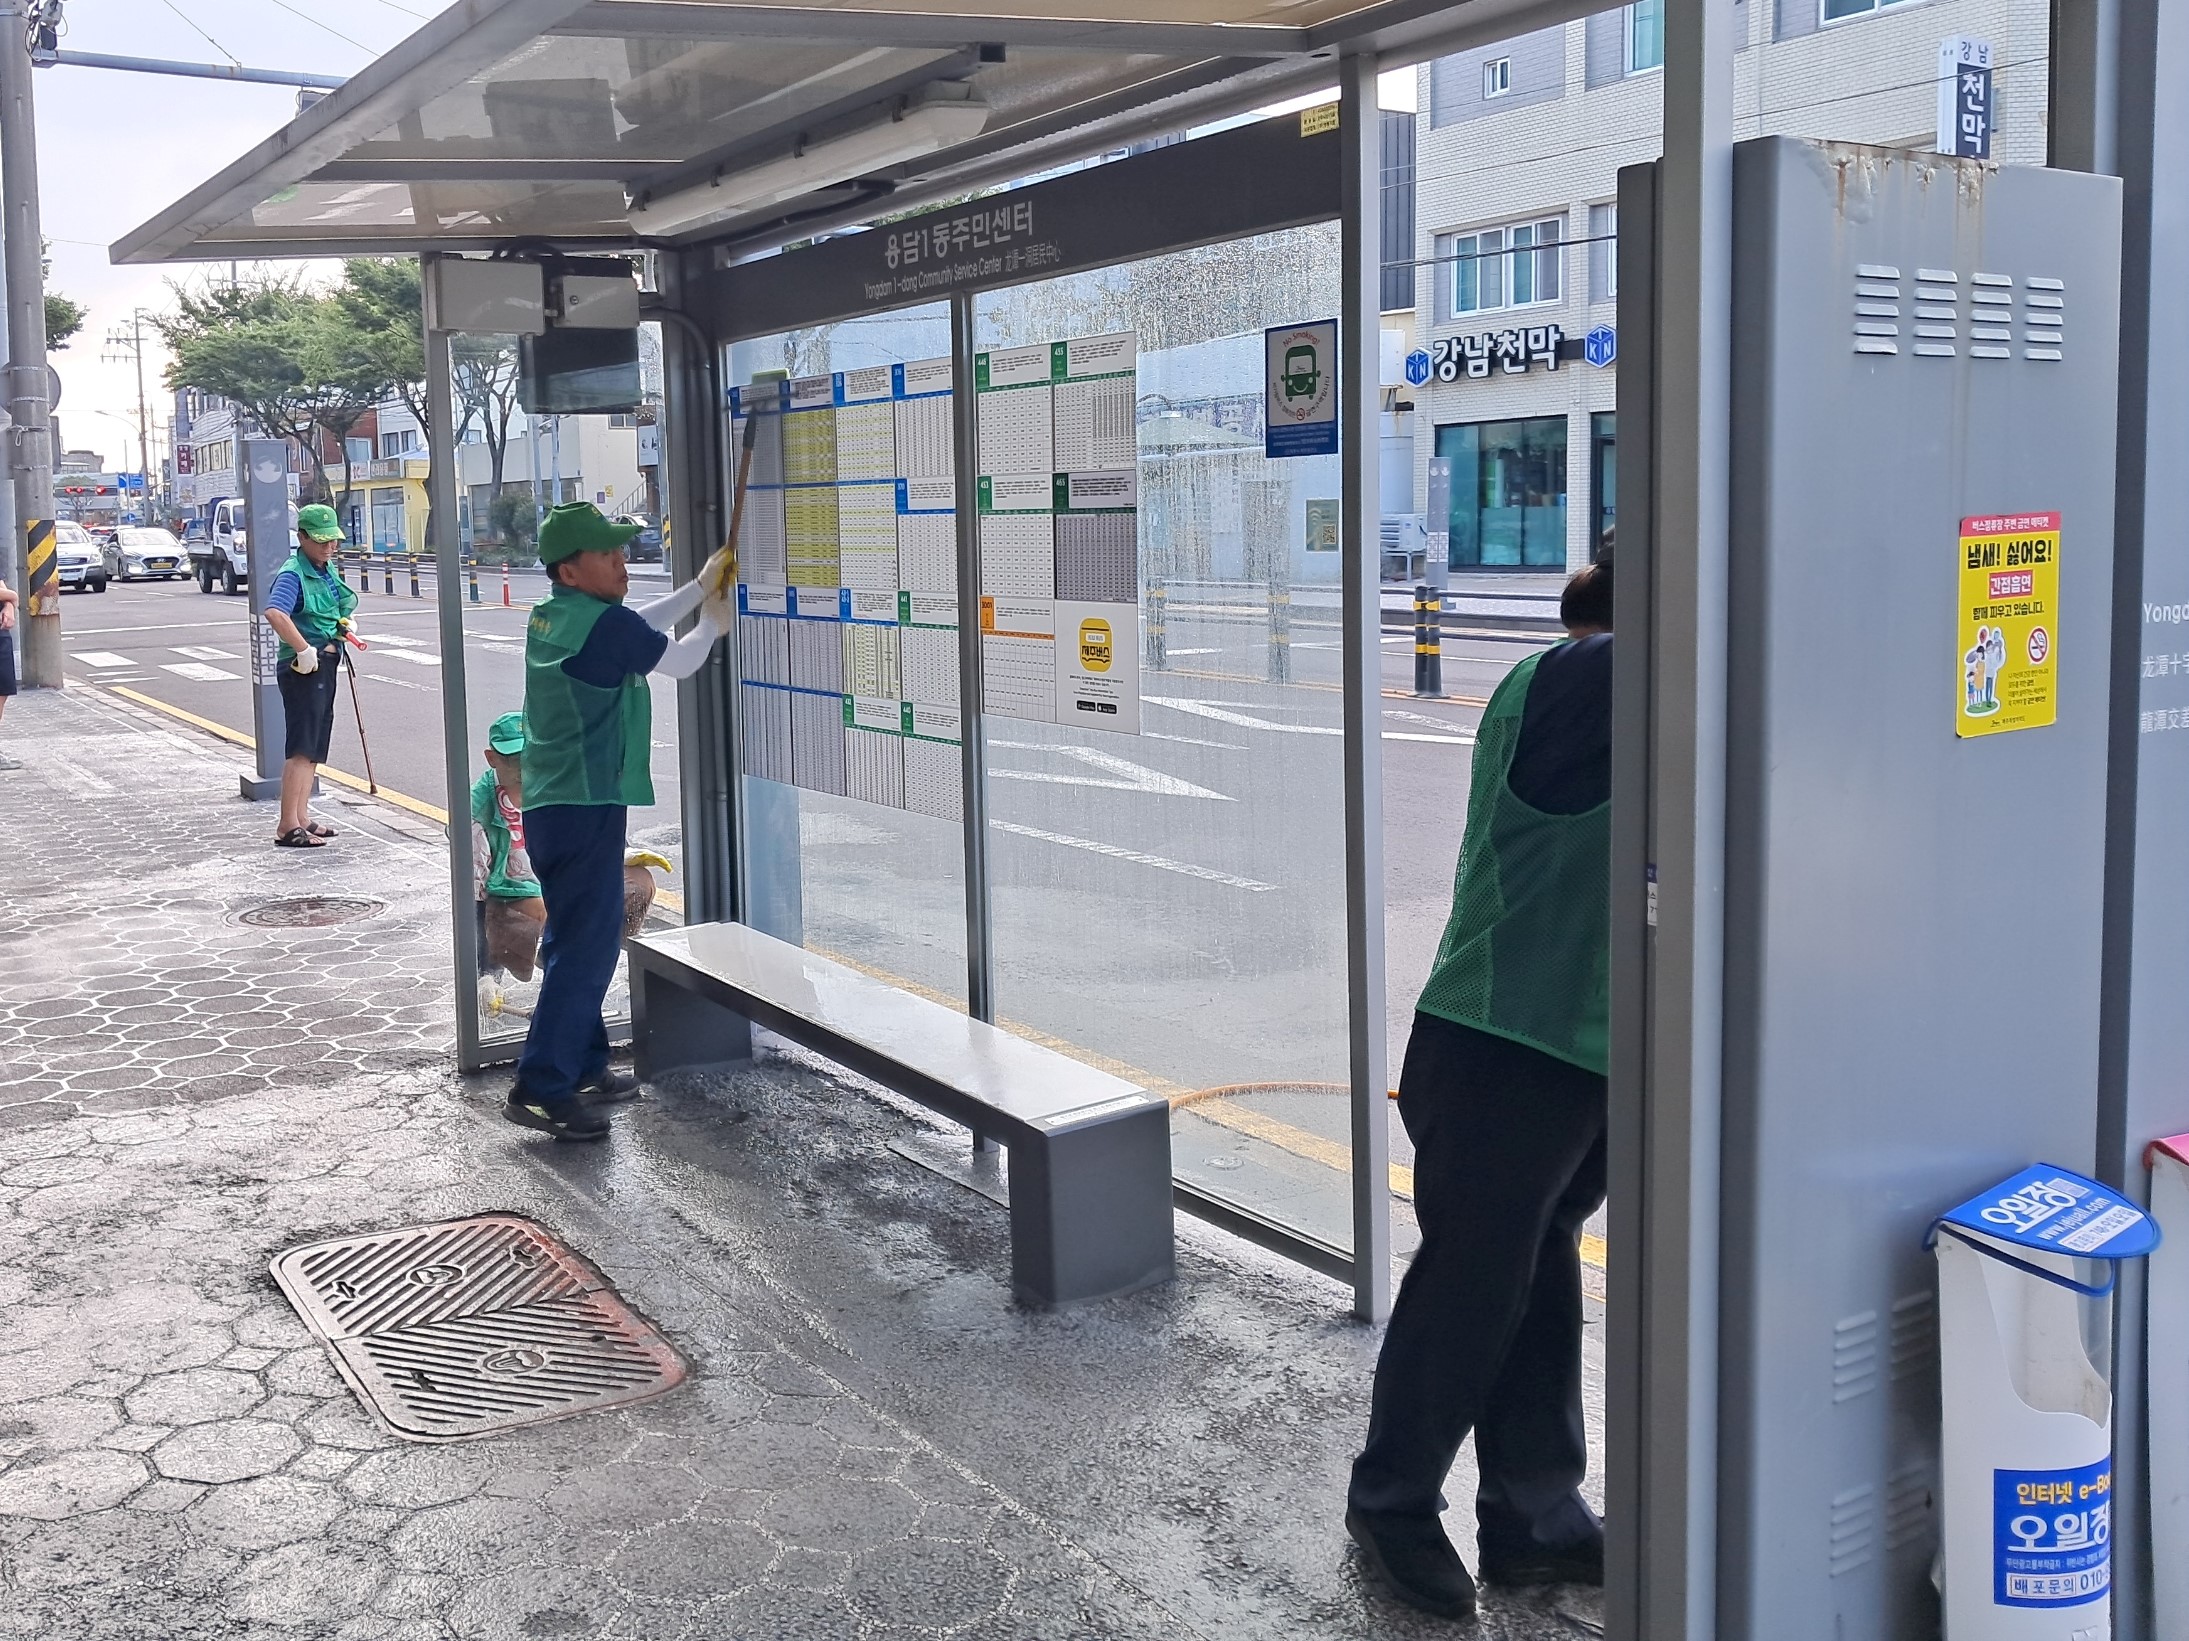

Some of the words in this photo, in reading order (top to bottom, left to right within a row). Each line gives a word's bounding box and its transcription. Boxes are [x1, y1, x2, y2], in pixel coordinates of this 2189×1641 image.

[1961, 41, 1989, 64] 강남
[1961, 73, 1986, 154] 천막
[885, 202, 1033, 269] 용담1동주민센터
[865, 280, 893, 299] Yongdam
[919, 265, 954, 288] Community
[954, 263, 977, 281] Service
[978, 256, 1002, 276] Center
[1433, 324, 1562, 382] 강남천막
[2004, 519, 2017, 530] 주변
[2017, 517, 2030, 529] 금연
[1967, 543, 2001, 569] 냄새!
[2006, 540, 2052, 566] 싫어요!
[1990, 574, 2031, 595] 간접흡연
[1973, 606, 1988, 621] 함께
[1990, 604, 2012, 618] 피우고
[2014, 601, 2044, 616] 있습니다.
[1981, 1181, 2077, 1234] 오일장
[2016, 1481, 2073, 1505] 인터넷
[2008, 1500, 2110, 1552] 오일장
[2014, 1577, 2074, 1595] 배포문의
